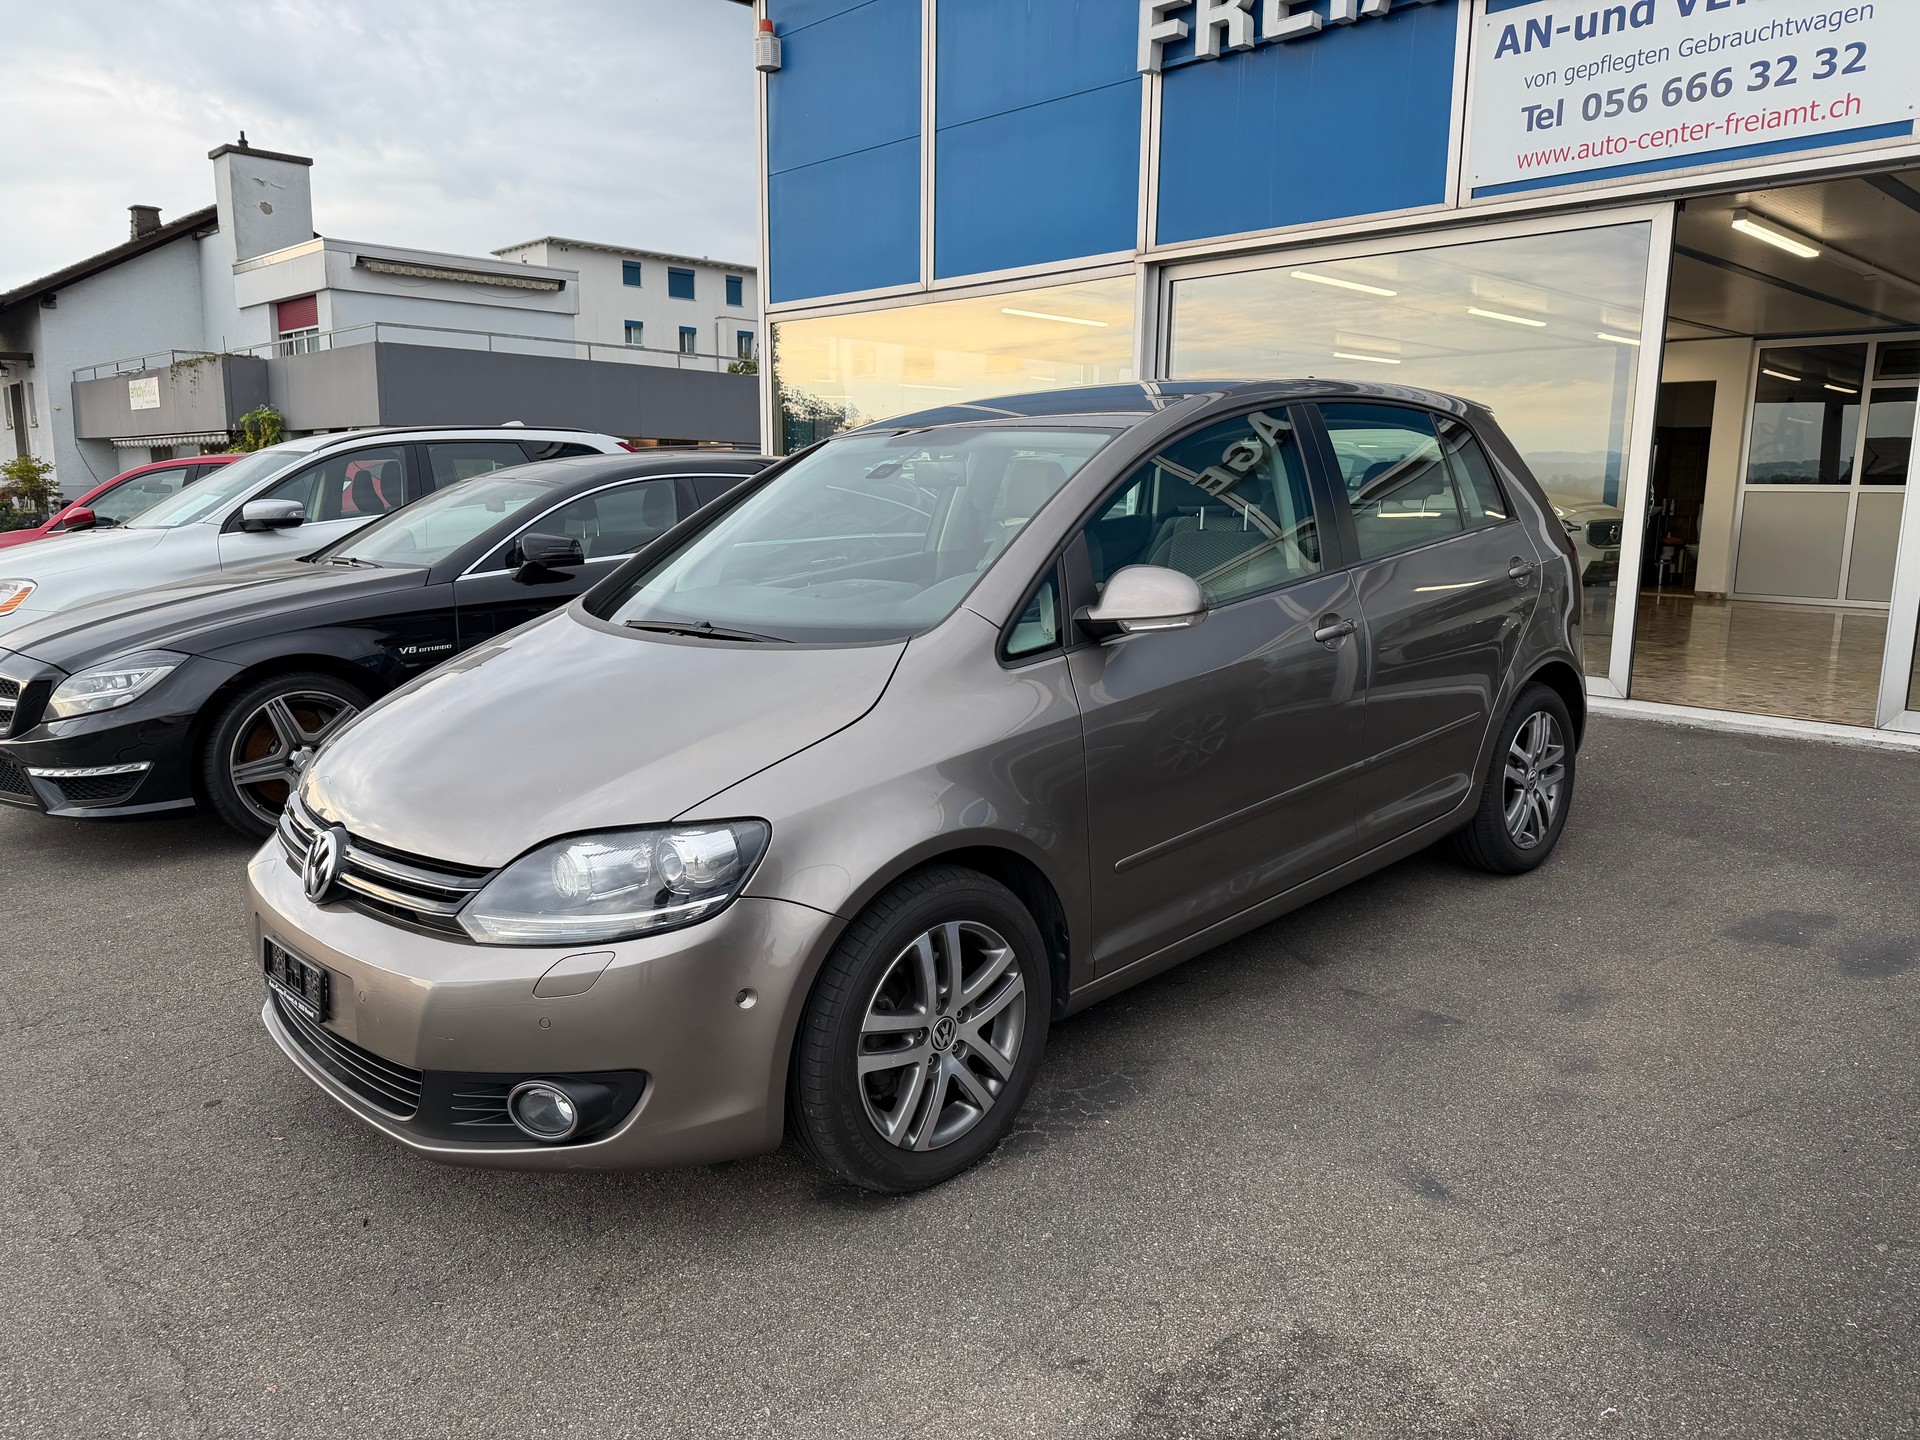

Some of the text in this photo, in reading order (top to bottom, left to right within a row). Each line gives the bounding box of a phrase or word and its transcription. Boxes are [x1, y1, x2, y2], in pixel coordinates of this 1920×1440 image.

[1137, 0, 1391, 74] FRE
[1494, 0, 1656, 59] AN-und
[1524, 70, 1557, 89] von
[1564, 47, 1670, 85] gepflegten
[1678, 4, 1874, 57] Gebrauchtwagen
[1521, 41, 1867, 132] Tel 056 666 32 32
[1517, 93, 1861, 169] www.auto-center-freiamt.ch
